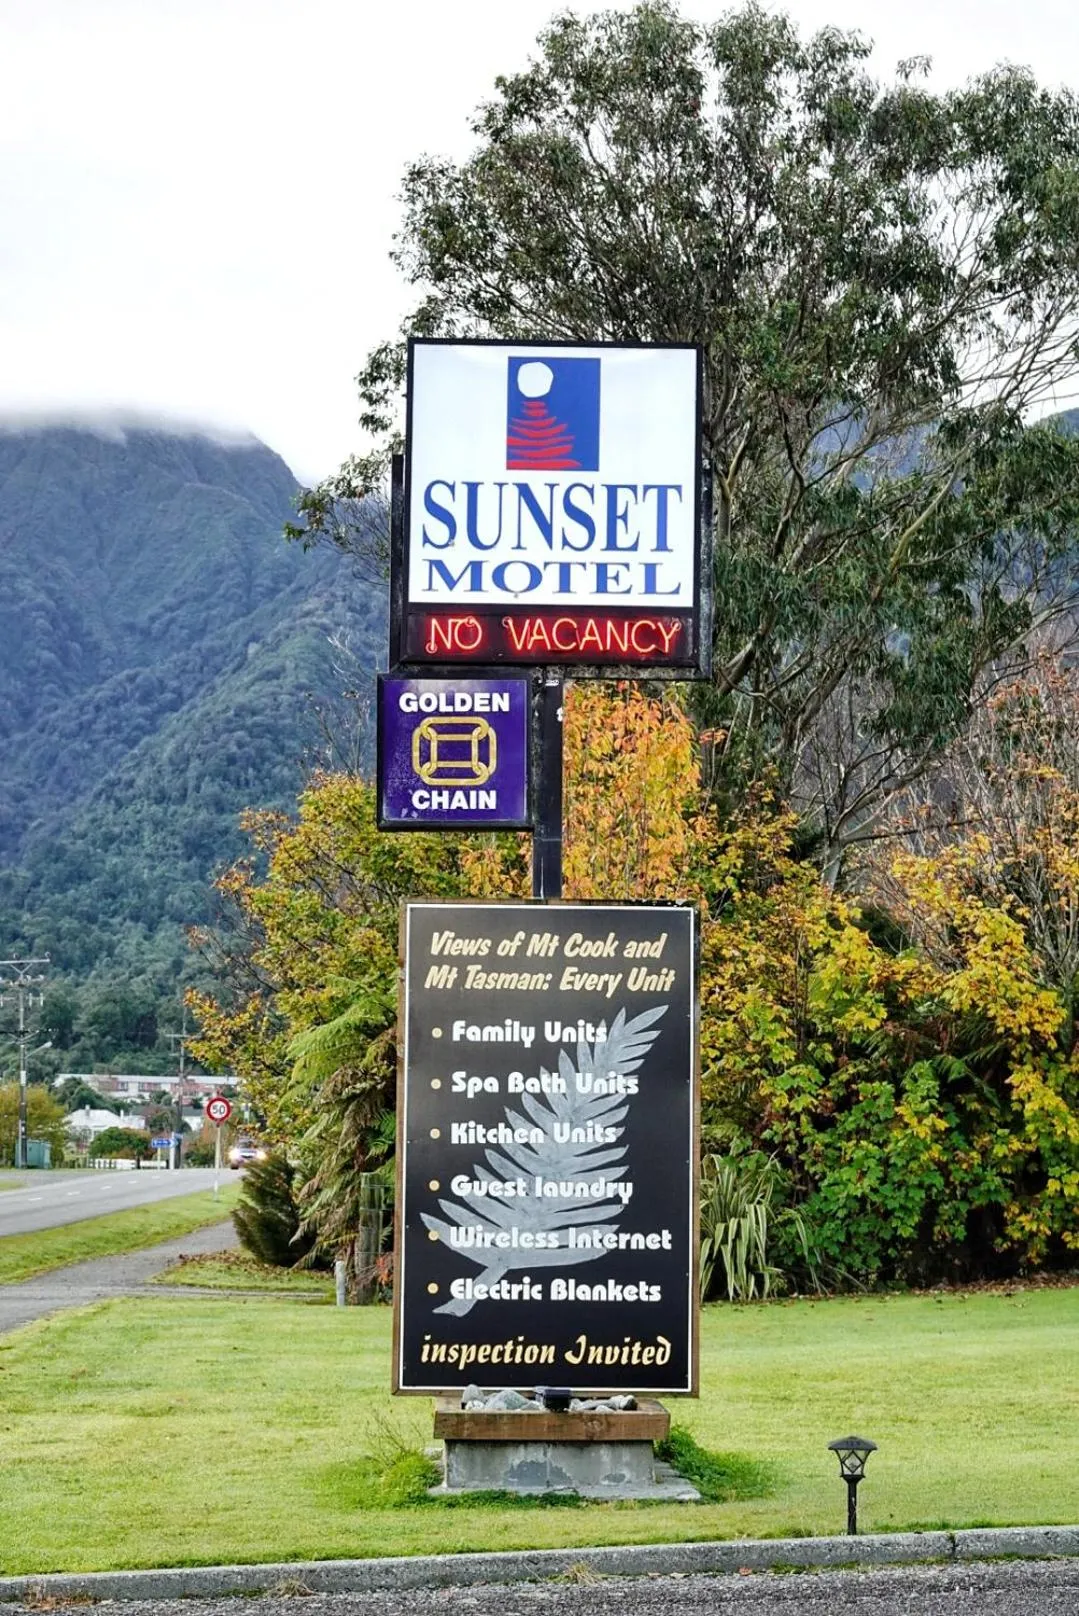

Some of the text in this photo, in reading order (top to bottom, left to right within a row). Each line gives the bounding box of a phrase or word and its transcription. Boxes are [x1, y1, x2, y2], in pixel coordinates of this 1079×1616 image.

[422, 479, 683, 552] SUNSET
[422, 558, 682, 598] MOTEL
[426, 615, 682, 654] NO VACANCY
[399, 692, 510, 712] GOLDEN
[411, 790, 497, 810] CHAIN
[430, 930, 668, 958] Views of Mt Cook and
[424, 964, 675, 998] Mt Tasman: Every Unit
[452, 1019, 608, 1048] Family Units
[452, 1071, 640, 1098] Spa Bath Units
[212, 1104, 226, 1115] 50
[451, 1121, 617, 1145] Kitchen Units
[451, 1174, 527, 1197] Guest
[449, 1225, 672, 1250] Wireless Internet
[450, 1276, 662, 1302] Electric Blankets
[564, 1335, 673, 1366] Invited
